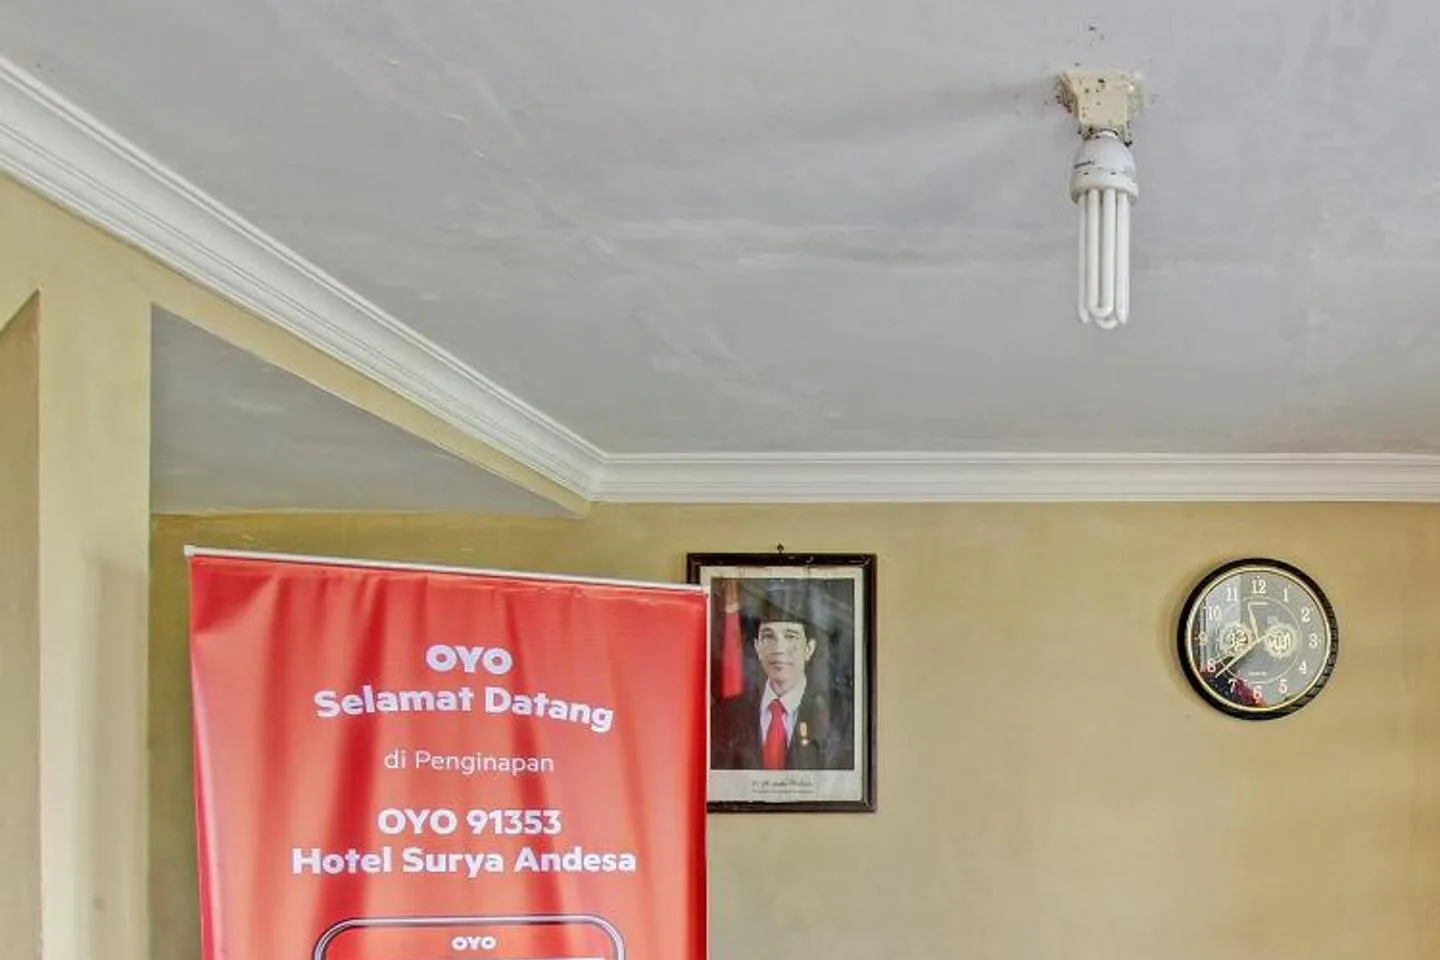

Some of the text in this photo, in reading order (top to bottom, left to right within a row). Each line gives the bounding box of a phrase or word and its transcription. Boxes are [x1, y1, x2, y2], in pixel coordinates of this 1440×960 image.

[1251, 579, 1266, 594] 12
[1226, 588, 1238, 601] 11
[1282, 588, 1289, 602] 1
[1207, 605, 1221, 621] 10
[1301, 607, 1311, 622] 2
[1198, 631, 1208, 646] 9
[1308, 633, 1318, 648] 3
[426, 644, 513, 675] OYO
[1207, 658, 1216, 672] 8
[1299, 660, 1307, 675] 4
[1228, 679, 1237, 693] 7
[1253, 685, 1263, 700] 6
[1278, 679, 1288, 693] 5
[314, 685, 613, 733] Selamat Datang
[384, 749, 554, 776] di Penginapan
[378, 808, 562, 834] OYO 91353
[292, 846, 636, 877] Hotel Surya Andesa
[451, 936, 496, 951] OYO
